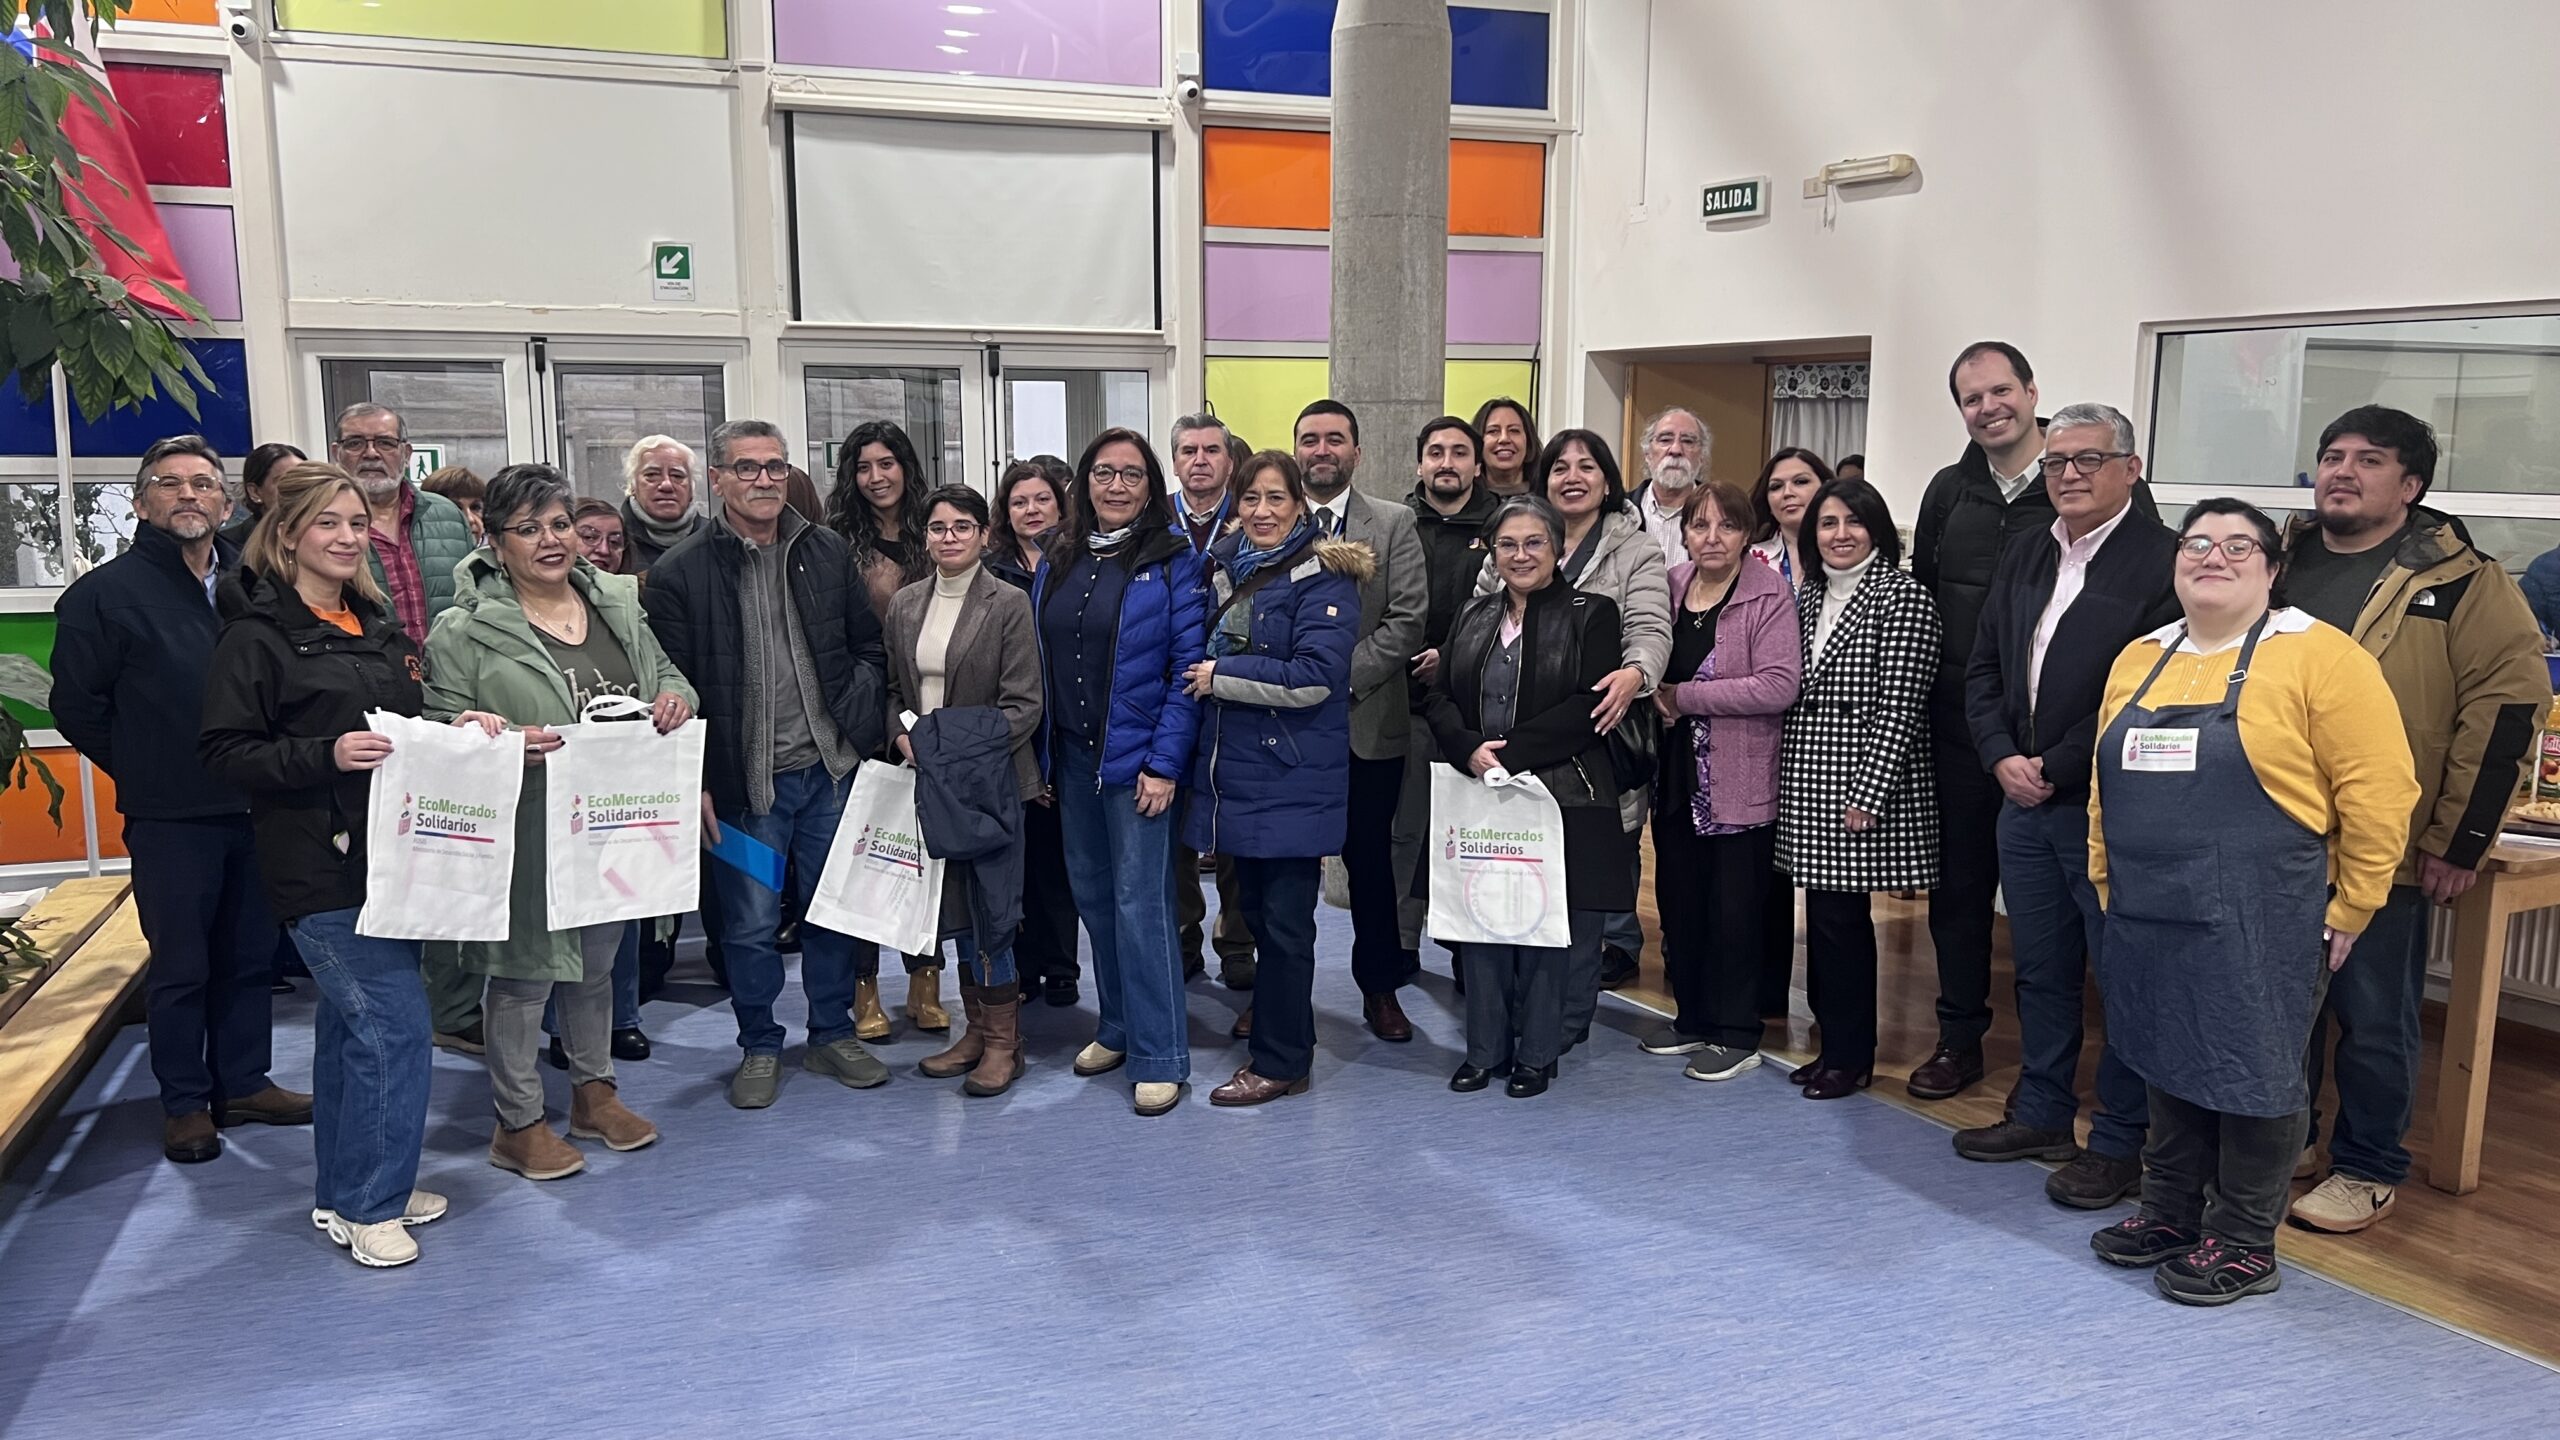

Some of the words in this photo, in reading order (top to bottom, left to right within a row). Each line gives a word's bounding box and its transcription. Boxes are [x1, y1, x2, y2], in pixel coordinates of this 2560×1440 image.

[1705, 187, 1752, 211] SALIDA
[418, 795, 497, 819] EcoMercados
[588, 791, 681, 808] EcoMercados
[416, 813, 477, 833] Solidarios
[588, 807, 658, 824] Solidarios
[874, 827, 927, 850] EcoMerc
[1460, 827, 1544, 842] EcoMercados
[1460, 841, 1524, 855] Solidarios
